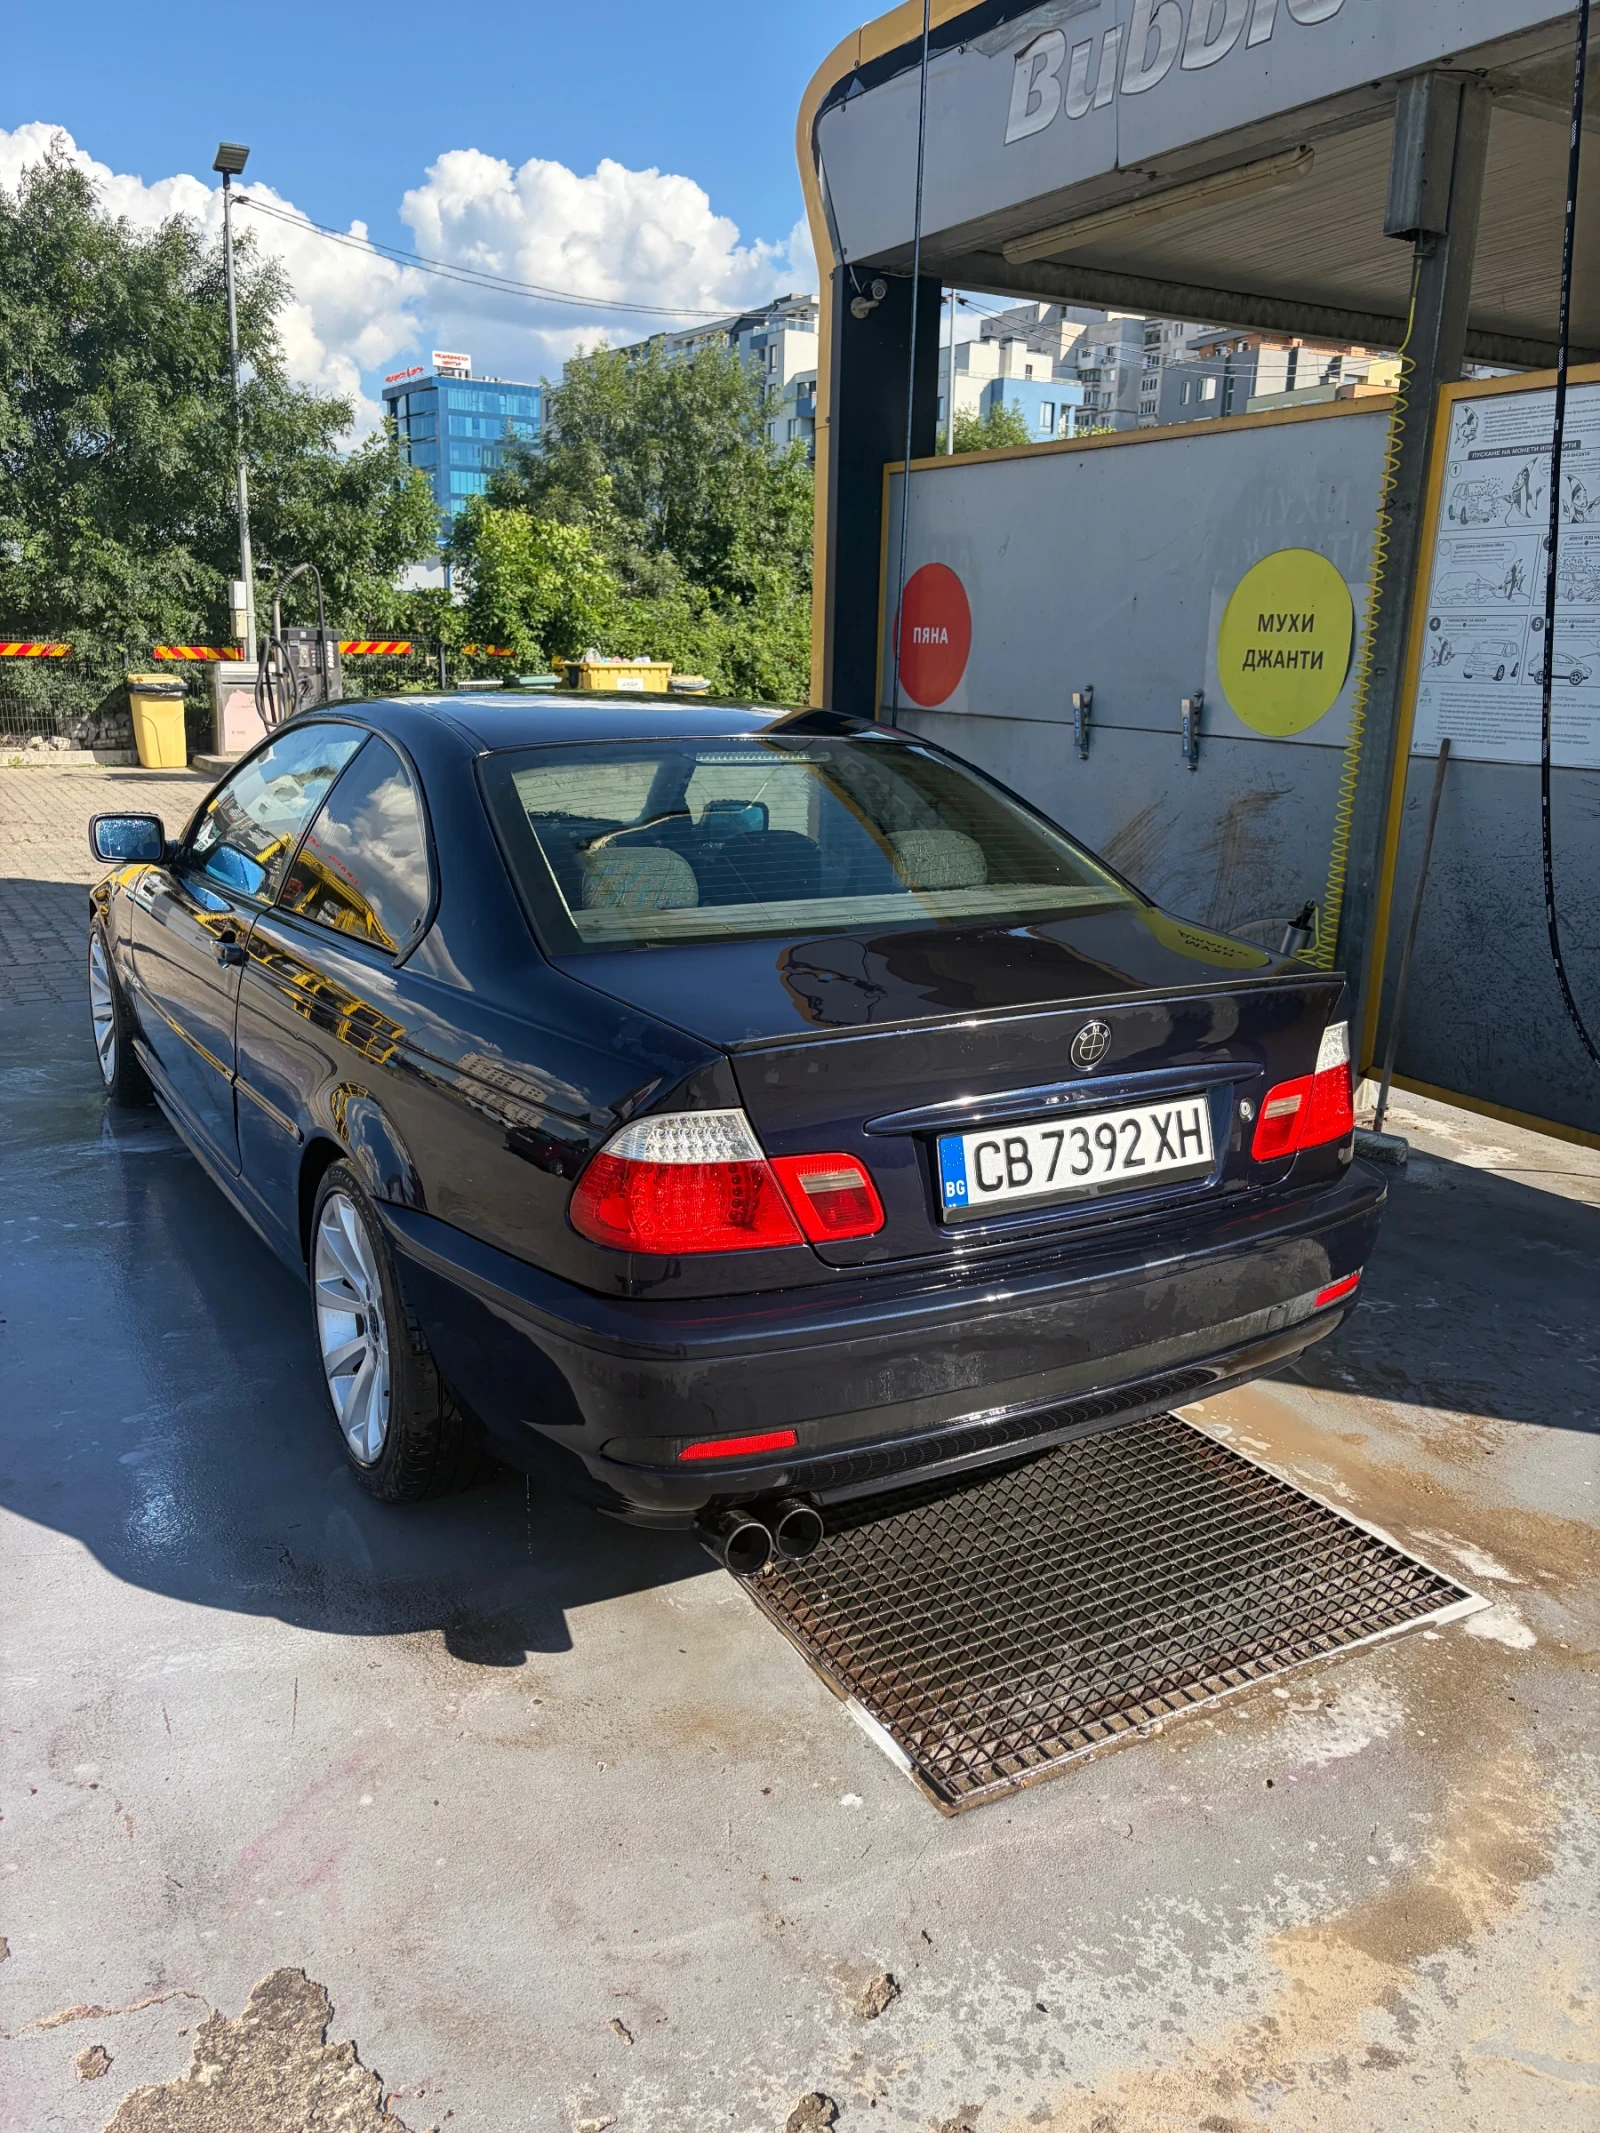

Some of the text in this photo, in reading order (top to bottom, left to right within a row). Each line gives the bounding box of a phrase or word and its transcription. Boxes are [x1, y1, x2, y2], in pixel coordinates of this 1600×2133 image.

[1472, 449, 1501, 459] ПУСКАНЕ
[1512, 446, 1539, 455] МОНЕТИ
[1562, 442, 1577, 450] АРТИ
[1257, 613, 1315, 634] МУХИ
[1432, 618, 1438, 629] 4
[1534, 618, 1541, 628] 5
[912, 626, 949, 645] ПЯНА
[1242, 650, 1324, 673] ДЖАНТИ
[974, 1107, 1204, 1193] CB 7392 XH
[945, 1180, 966, 1198] BG
